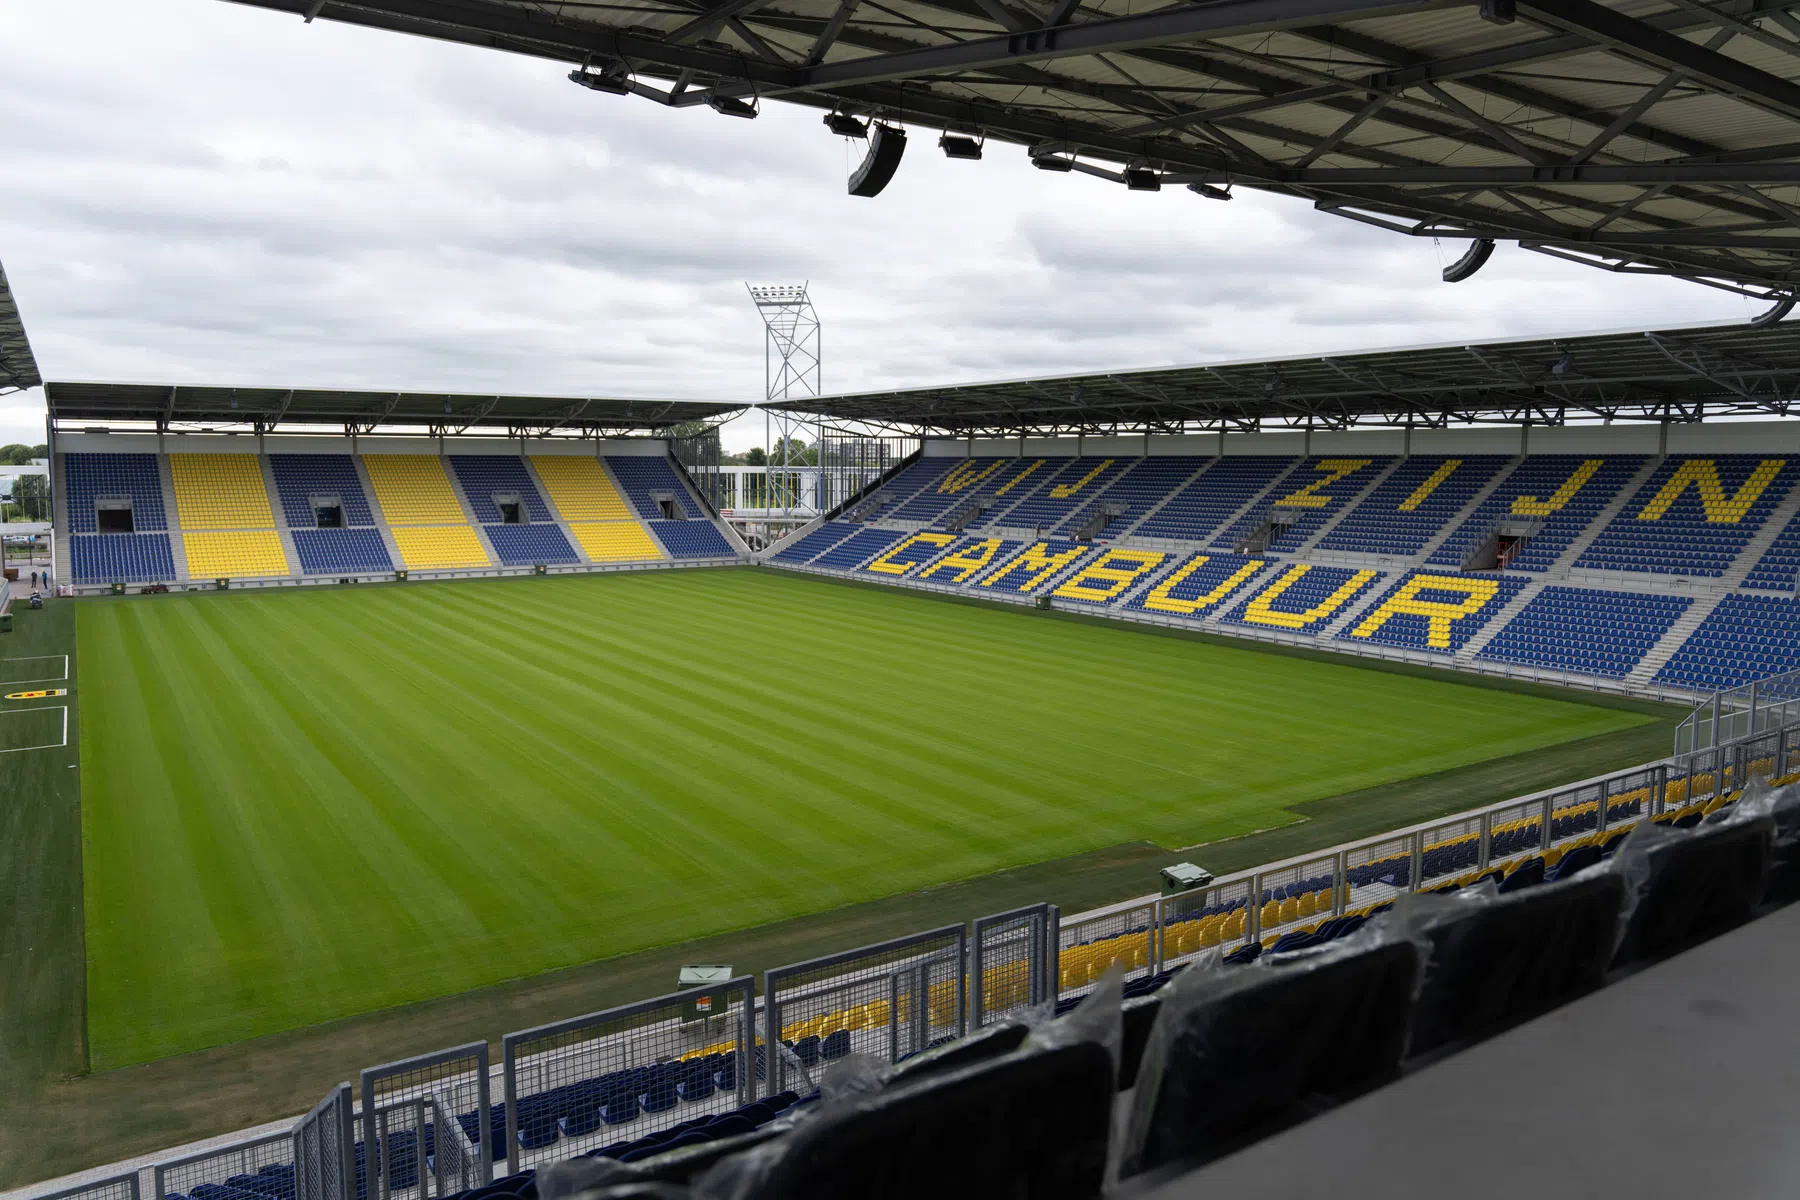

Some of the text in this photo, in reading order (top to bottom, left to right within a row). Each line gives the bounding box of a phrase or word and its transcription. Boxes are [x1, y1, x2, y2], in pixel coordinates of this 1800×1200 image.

[937, 459, 1787, 524] WIJ ZIJN
[867, 532, 1500, 649] CAMBUUR
